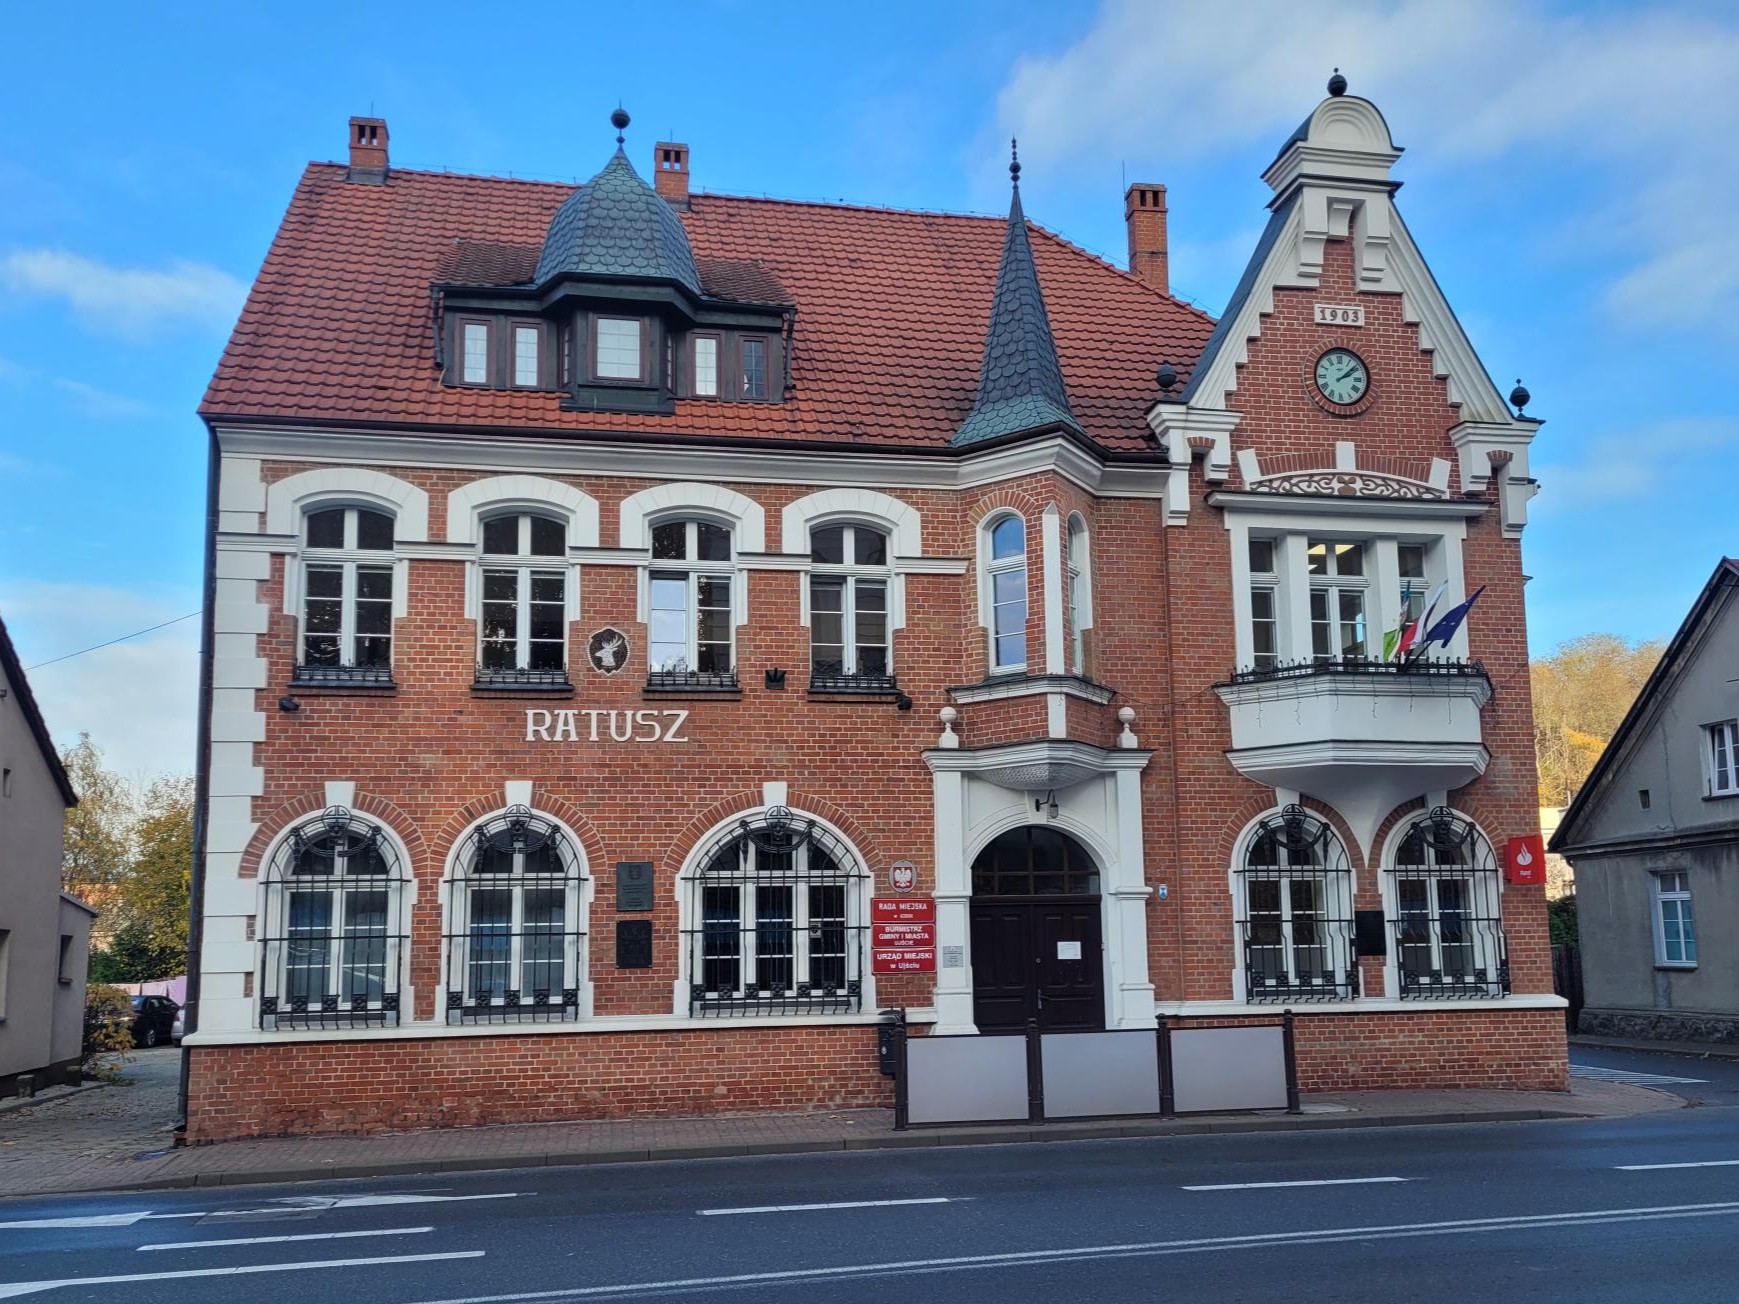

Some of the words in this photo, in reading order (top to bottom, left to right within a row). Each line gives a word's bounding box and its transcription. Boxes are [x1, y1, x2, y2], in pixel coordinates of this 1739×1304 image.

[1319, 308, 1359, 322] 1903
[525, 709, 689, 742] RATUSZ
[877, 953, 902, 961] URZĄD
